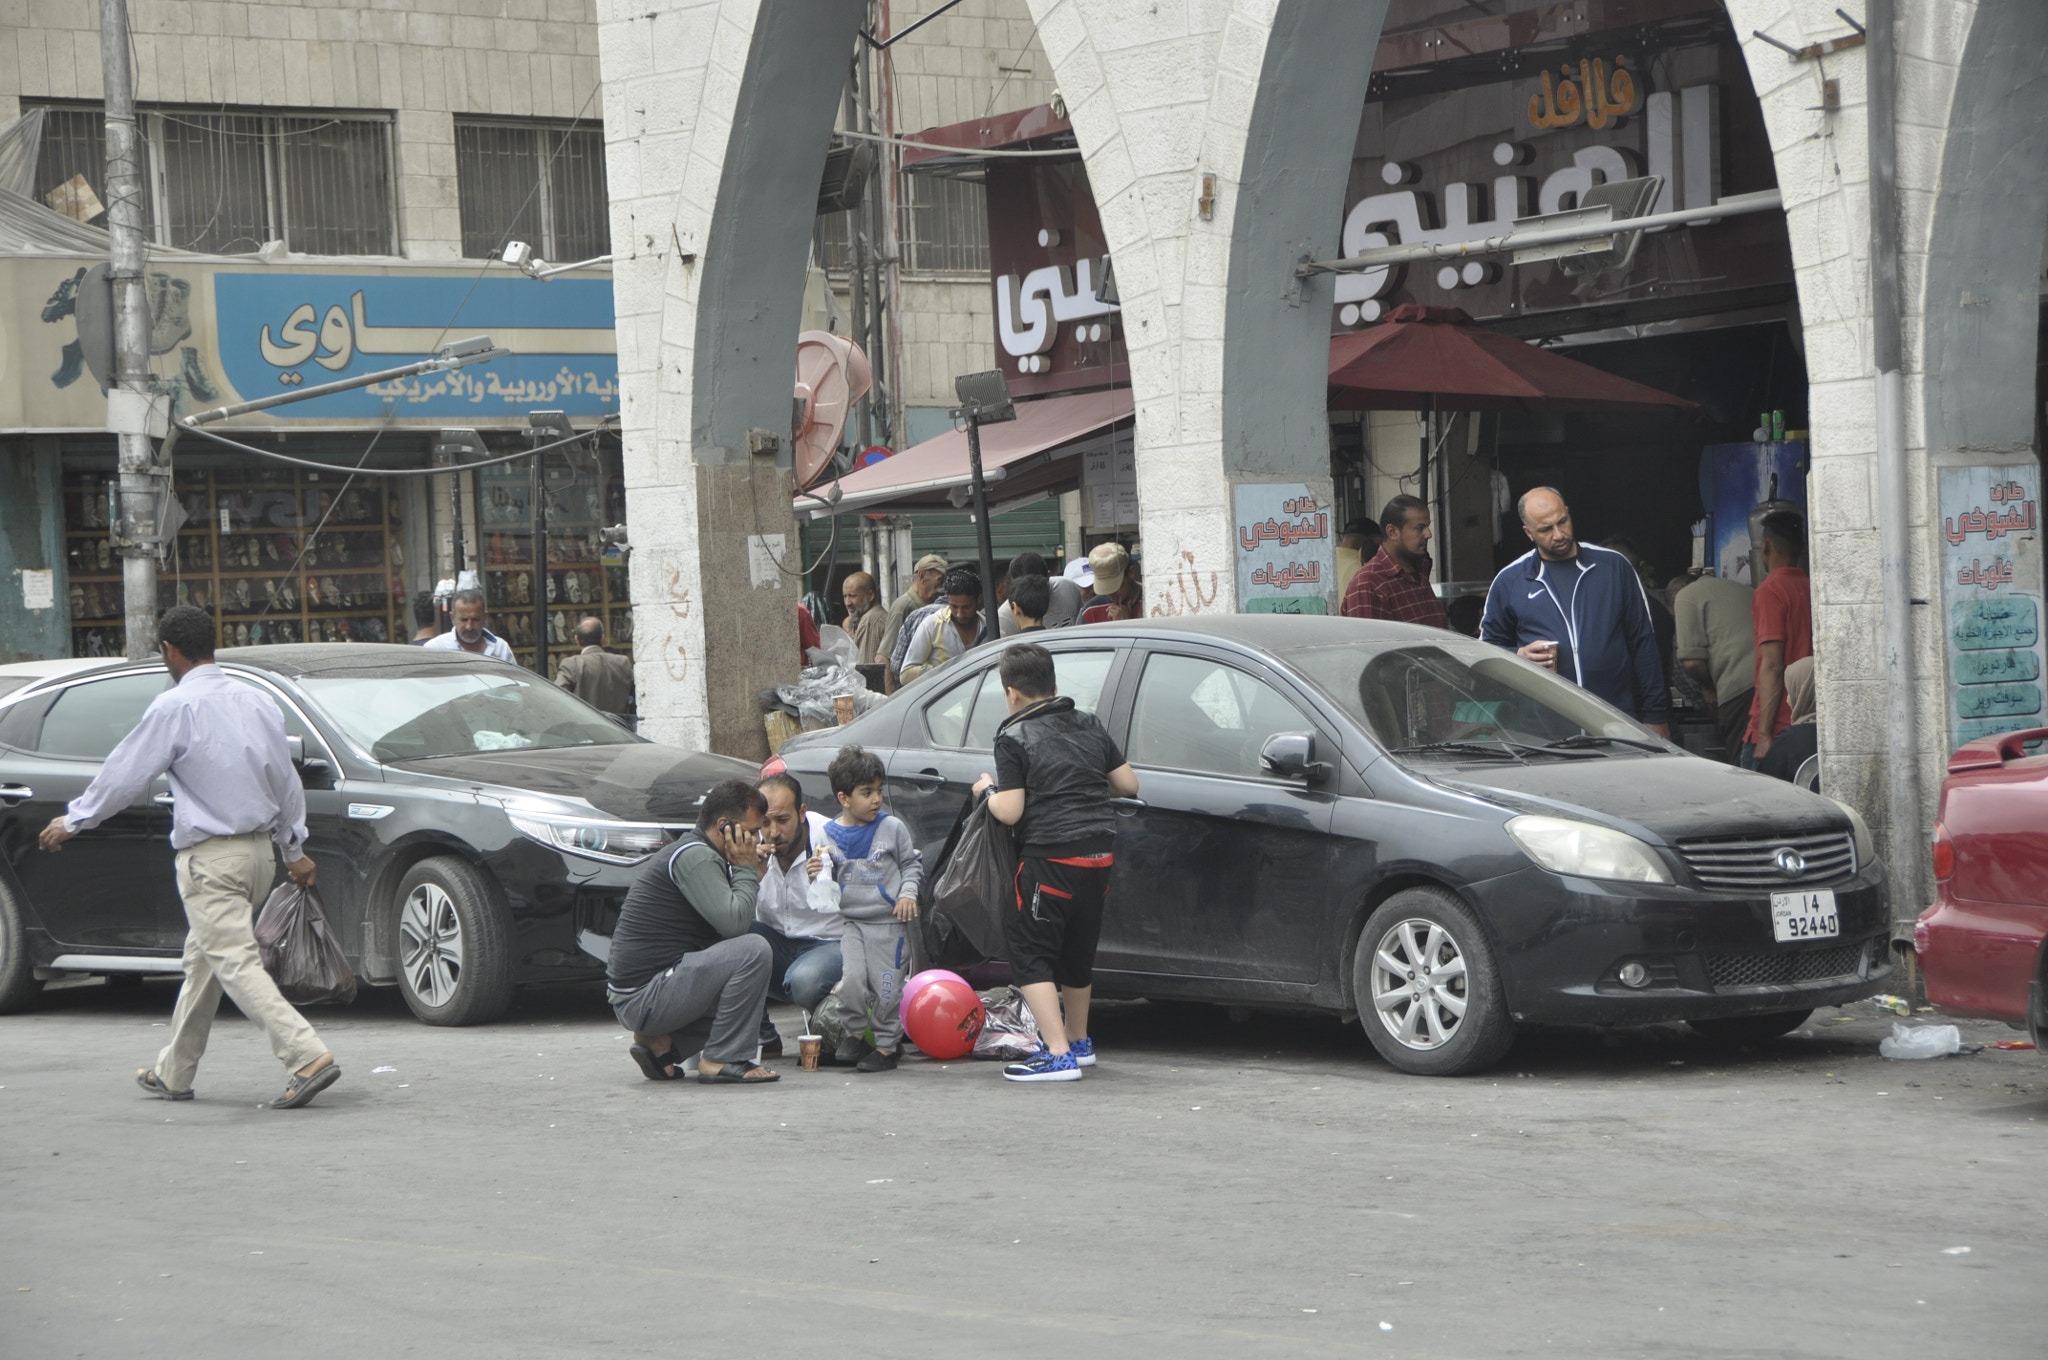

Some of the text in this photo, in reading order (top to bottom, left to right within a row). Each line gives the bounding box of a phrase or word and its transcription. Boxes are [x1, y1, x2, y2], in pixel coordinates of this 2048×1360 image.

[1528, 54, 1636, 130] فلافل
[486, 366, 582, 403] الأوروبية
[1240, 513, 1328, 551] الشيوخي
[1946, 500, 2037, 547] الشيوخي
[1251, 561, 1320, 589] للخلويات
[1958, 558, 2013, 590] خلويات
[1803, 894, 1819, 913] 14
[1789, 915, 1836, 937] 92440
